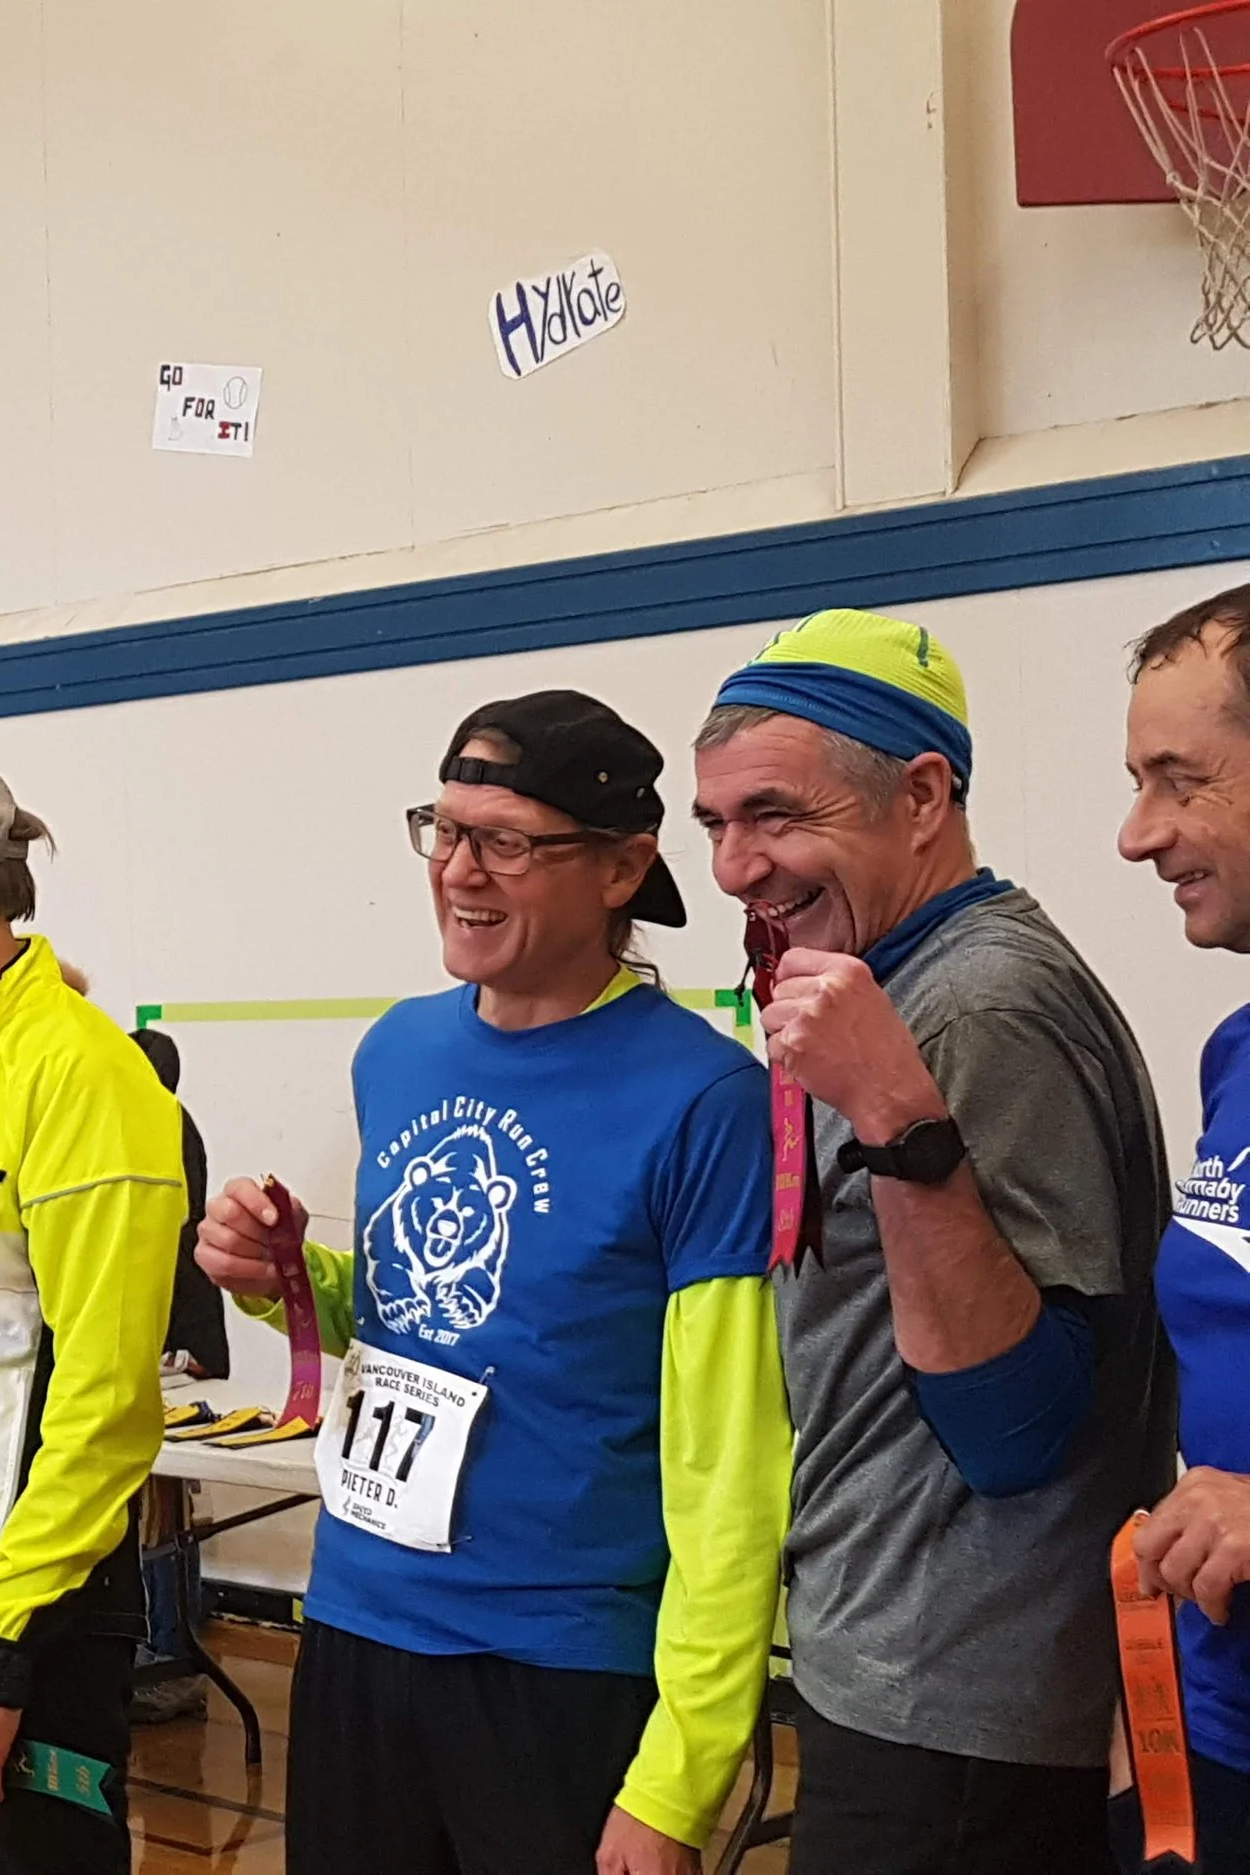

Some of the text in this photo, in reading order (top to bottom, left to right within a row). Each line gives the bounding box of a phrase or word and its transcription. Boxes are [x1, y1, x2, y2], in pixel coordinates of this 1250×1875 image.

[496, 258, 622, 376] Hydrate
[160, 364, 183, 391] GO
[182, 397, 216, 420] FOR
[217, 420, 249, 442] IT!
[376, 1096, 551, 1214] Capital City Run Crew
[419, 1323, 461, 1347] Est 2017
[362, 1363, 466, 1407] VANCOUVER ISLAND
[375, 1377, 440, 1408] RACE SERIES
[340, 1389, 437, 1483] 117
[340, 1469, 398, 1509] PIETER D.
